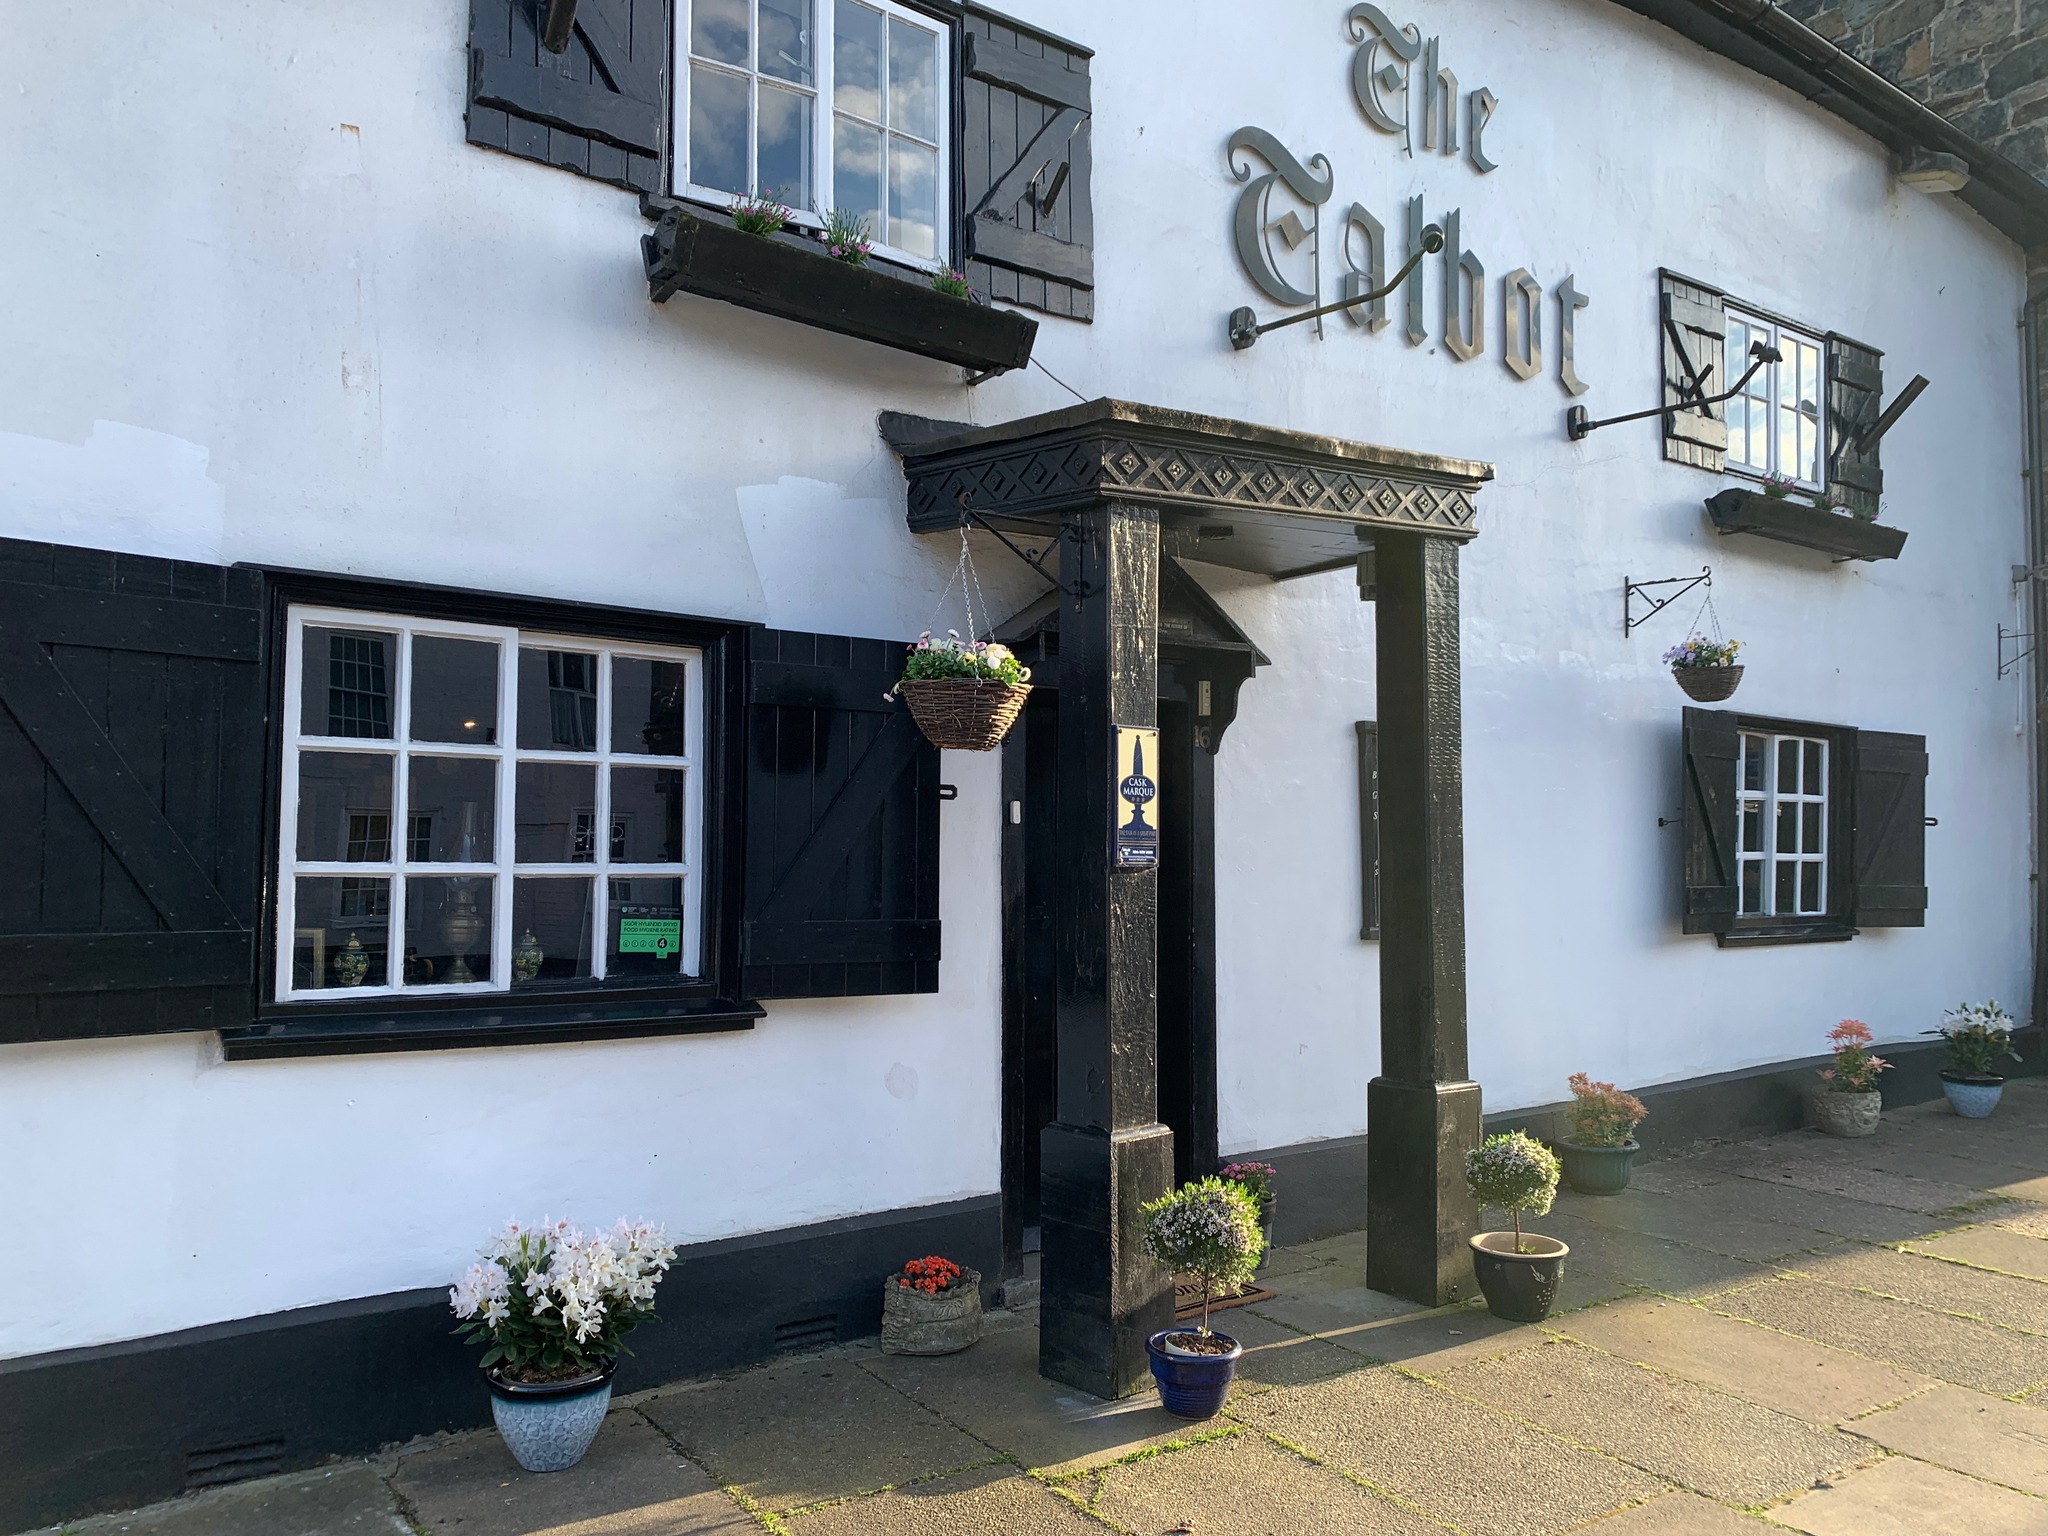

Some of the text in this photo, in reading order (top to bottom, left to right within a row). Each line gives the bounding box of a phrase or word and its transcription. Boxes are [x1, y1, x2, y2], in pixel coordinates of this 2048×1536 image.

[1348, 2, 1499, 173] The
[1227, 126, 1590, 396] Talbot
[1195, 725, 1211, 748] 16
[1128, 777, 1147, 787] CASK
[1123, 787, 1154, 797] MARQUE
[659, 939, 665, 948] 4
